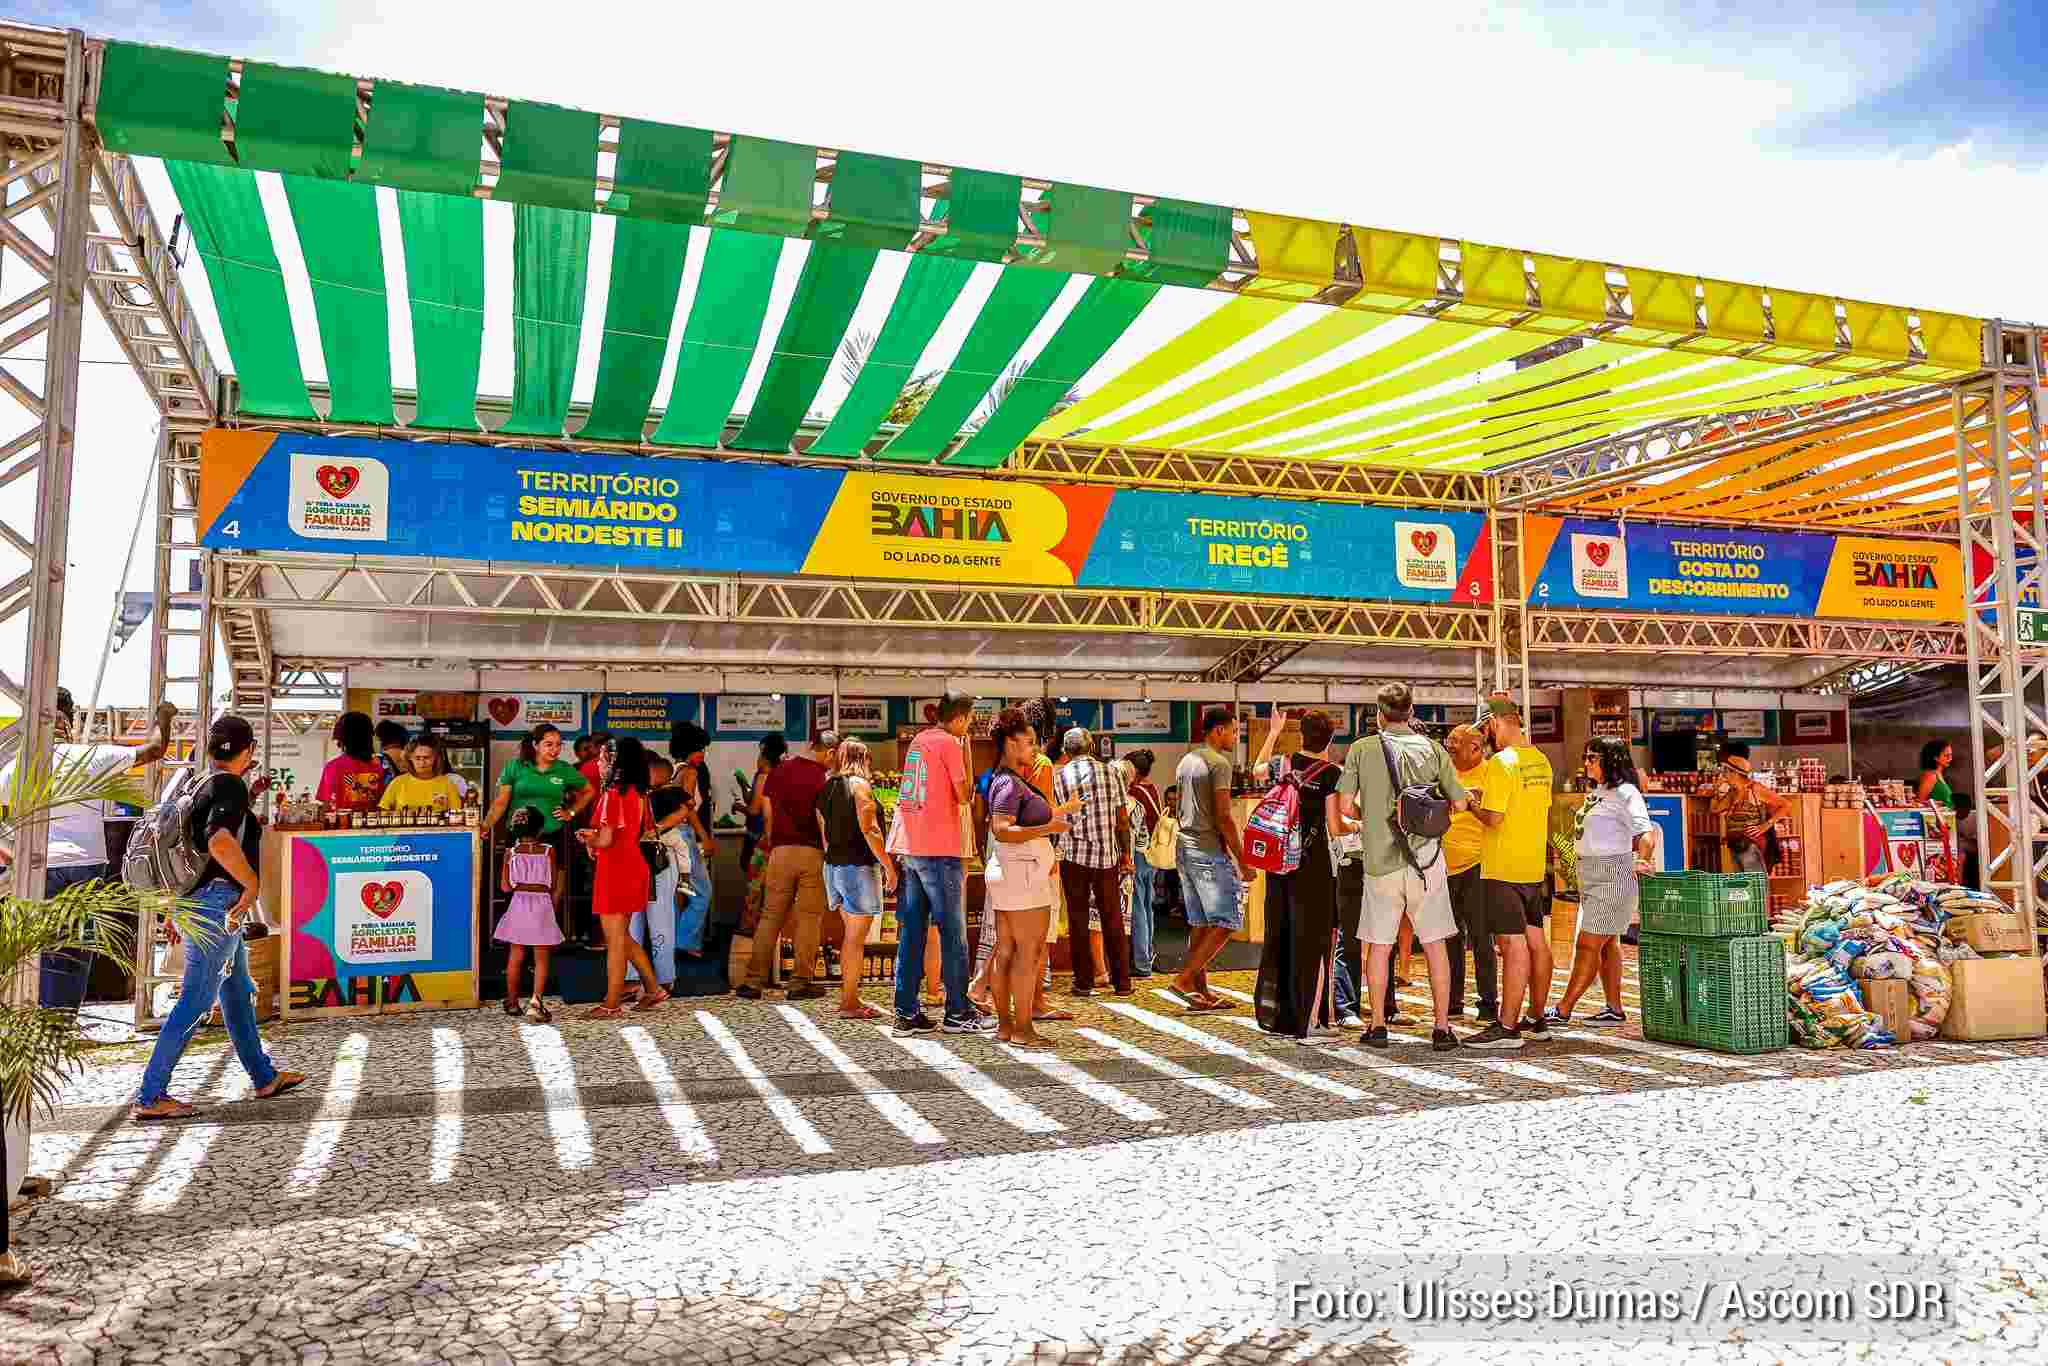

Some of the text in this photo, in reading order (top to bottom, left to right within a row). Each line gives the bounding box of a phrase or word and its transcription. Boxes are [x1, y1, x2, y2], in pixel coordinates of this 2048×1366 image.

[517, 470, 679, 498] TERRITÓRIO
[519, 495, 677, 522] SEMIÁRIDO
[872, 491, 1012, 510] GOVERNO DO ESTADO
[305, 506, 371, 516] AGRICULTURA
[305, 513, 371, 527] FAMILIAR
[222, 520, 241, 538] 4
[872, 503, 1012, 542] BAHIA
[1187, 518, 1307, 541] TERRITÓRIO
[512, 520, 682, 548] NORDESTE II
[883, 551, 1000, 567] DO LADO DA GENTE
[1208, 542, 1288, 568] IRECÊ
[1670, 541, 1764, 560] TERRITÓRIO
[1852, 551, 1892, 562] GOVERNO
[1894, 554, 1907, 562] DO
[1679, 560, 1759, 579] COSTA DO
[1854, 560, 1938, 590] BAHIA
[1470, 582, 1481, 596] 3
[1538, 582, 1550, 597] 2
[1648, 578, 1789, 599] DESCOBRIMENTO
[1912, 600, 1936, 608] GENTE
[352, 934, 416, 949] FAMILIAR
[288, 974, 422, 1009] BAHIA
